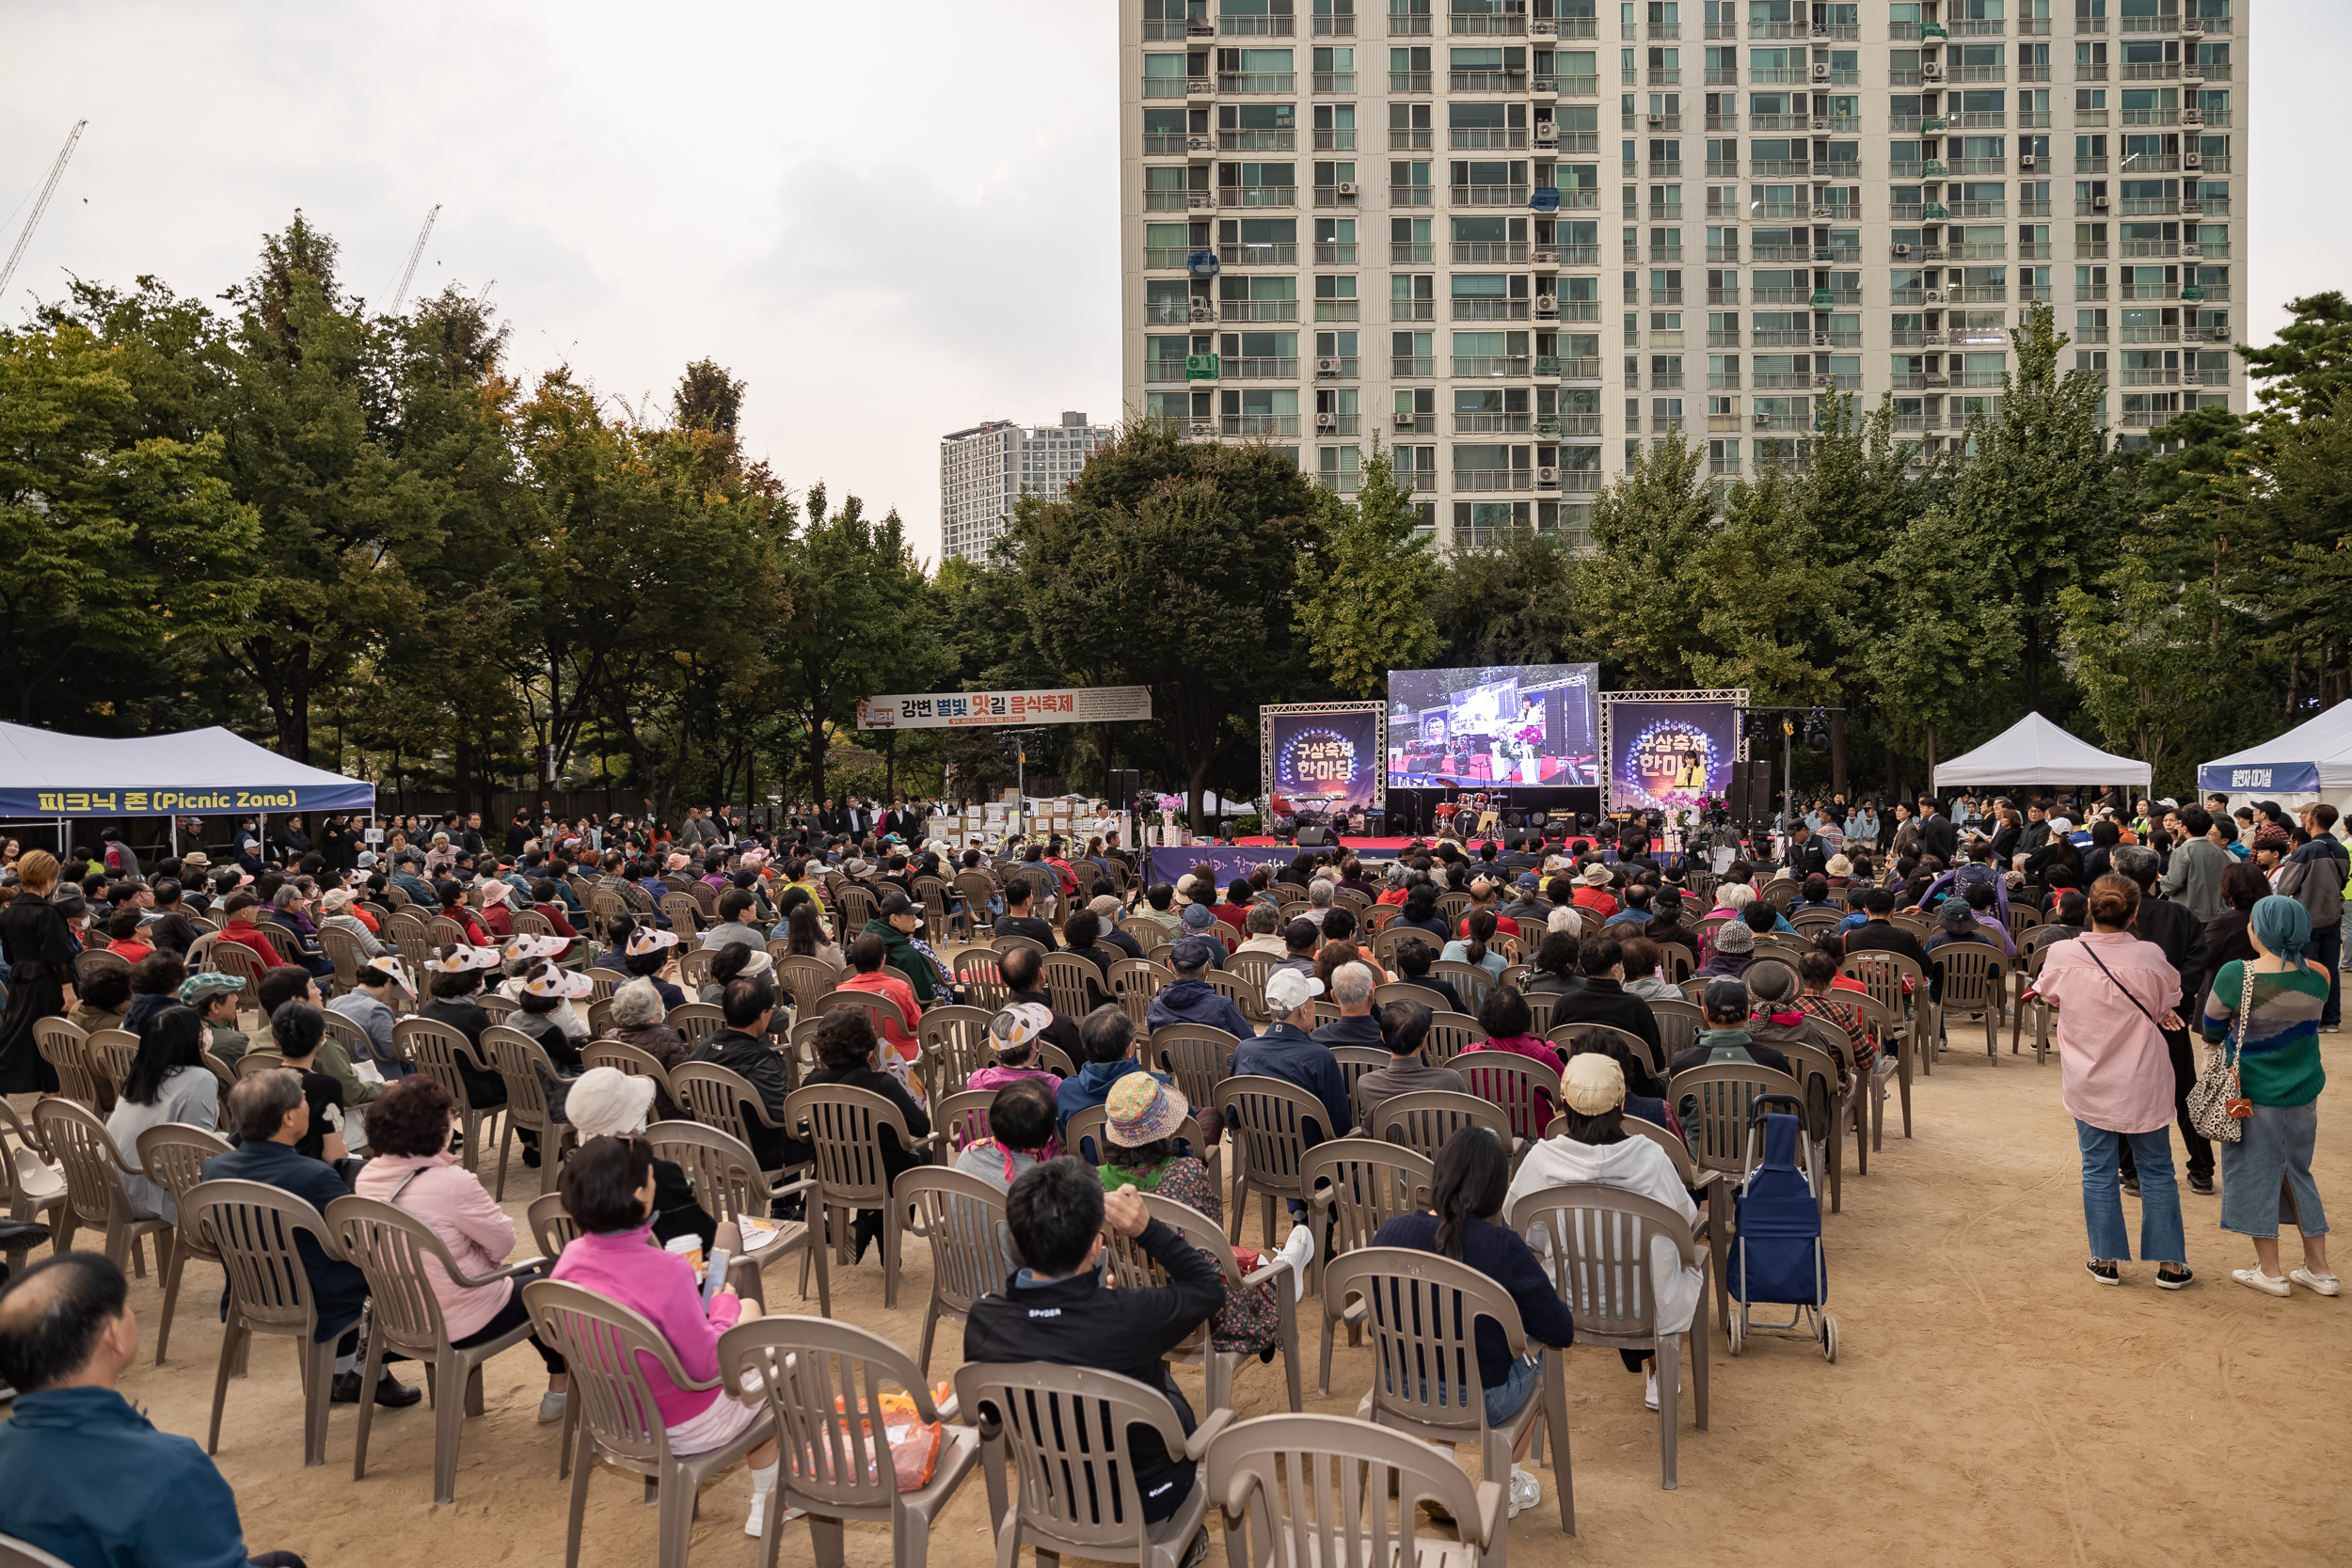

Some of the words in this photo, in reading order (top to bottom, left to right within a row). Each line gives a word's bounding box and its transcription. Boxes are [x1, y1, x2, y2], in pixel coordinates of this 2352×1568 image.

[901, 699, 932, 718] 강변
[936, 698, 967, 717] 별빛
[972, 694, 1006, 716] 맛길
[1010, 693, 1073, 714] 음식축제
[1297, 741, 1354, 759] 구삼축제
[1640, 734, 1708, 752] 구삼축제
[1297, 760, 1352, 782] 한마당
[1640, 753, 1708, 777] 한마
[2232, 768, 2251, 787] 출연자
[2250, 768, 2272, 787] 대기실
[39, 793, 117, 811] 피크닉
[124, 793, 148, 810] 존
[153, 791, 230, 811] (Picnic
[236, 789, 297, 808] Zone)
[1028, 1307, 1061, 1318] SPYDER
